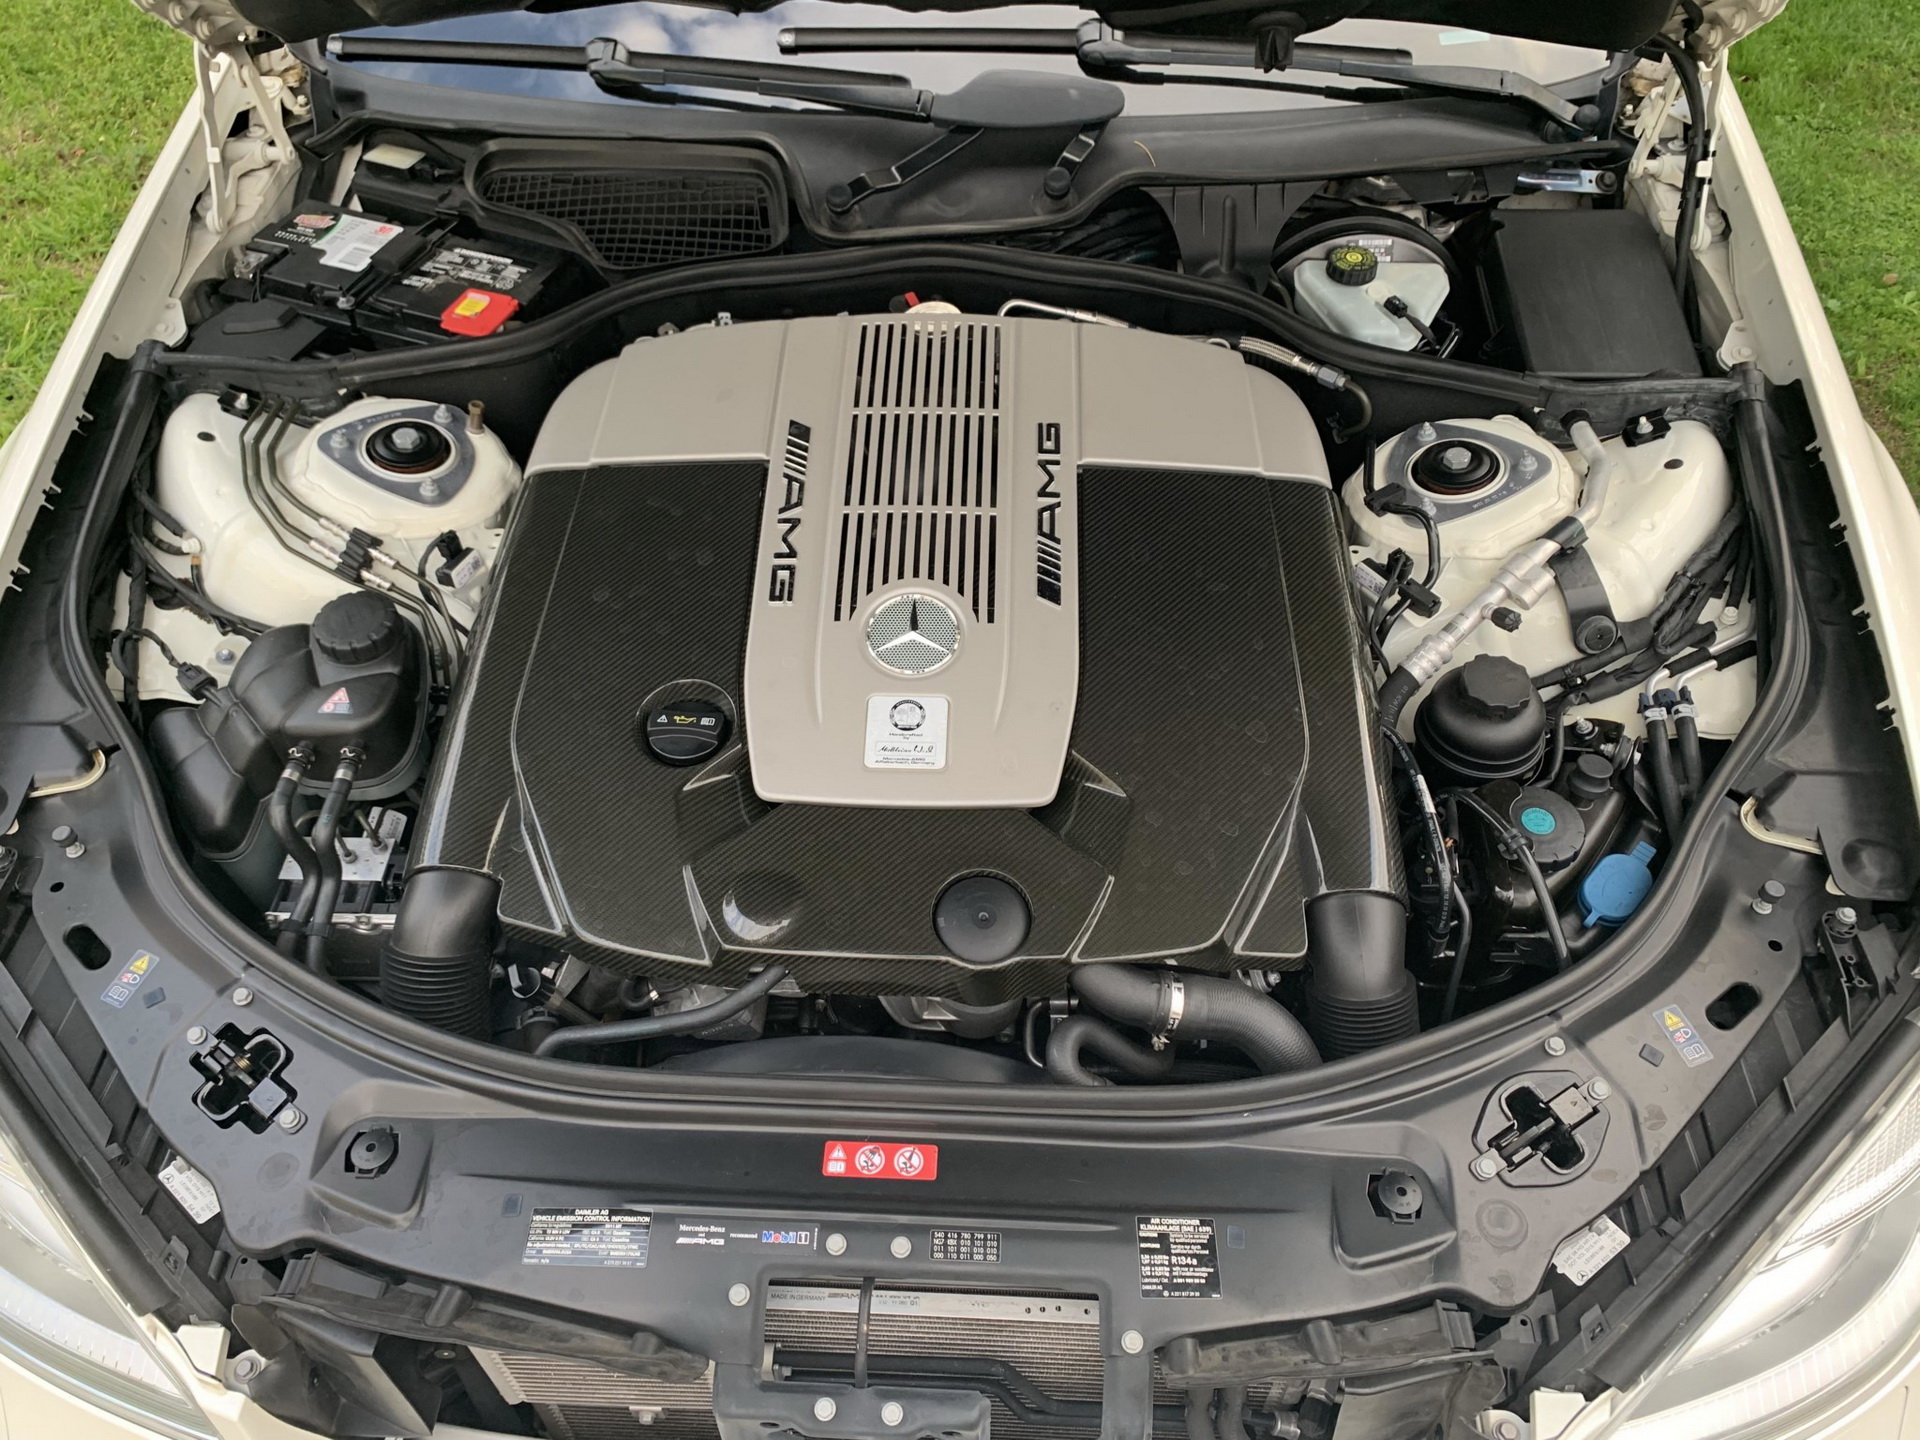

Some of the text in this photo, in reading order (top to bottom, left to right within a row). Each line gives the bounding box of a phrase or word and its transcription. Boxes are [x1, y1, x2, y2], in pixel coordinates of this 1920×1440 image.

[1037, 422, 1061, 550] AMG
[768, 465, 806, 604] AMG
[679, 1224, 725, 1233] Mercedes-Benz
[762, 1230, 796, 1244] Mobil
[1171, 1256, 1197, 1265] R134a
